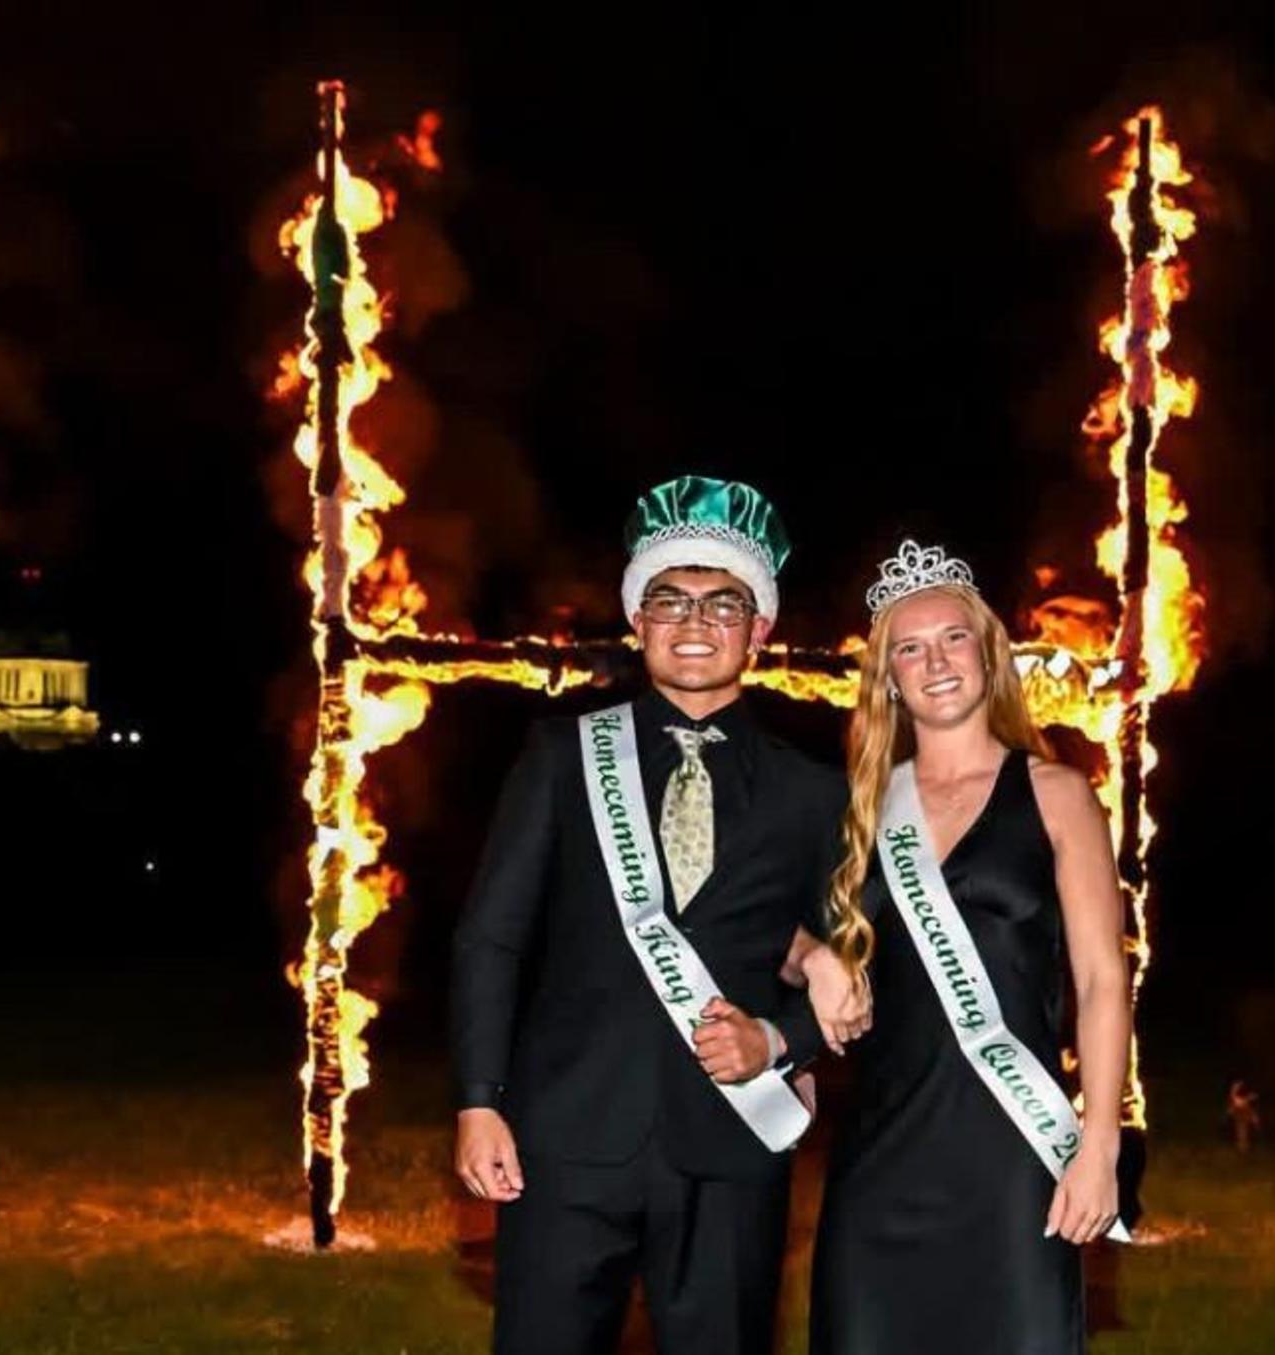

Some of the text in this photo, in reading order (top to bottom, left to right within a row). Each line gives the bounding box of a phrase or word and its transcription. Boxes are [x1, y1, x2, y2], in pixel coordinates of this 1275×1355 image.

[589, 714, 694, 1006] Homecoming King
[885, 825, 987, 1032] Homecoming
[980, 1043, 1058, 1135] Queen
